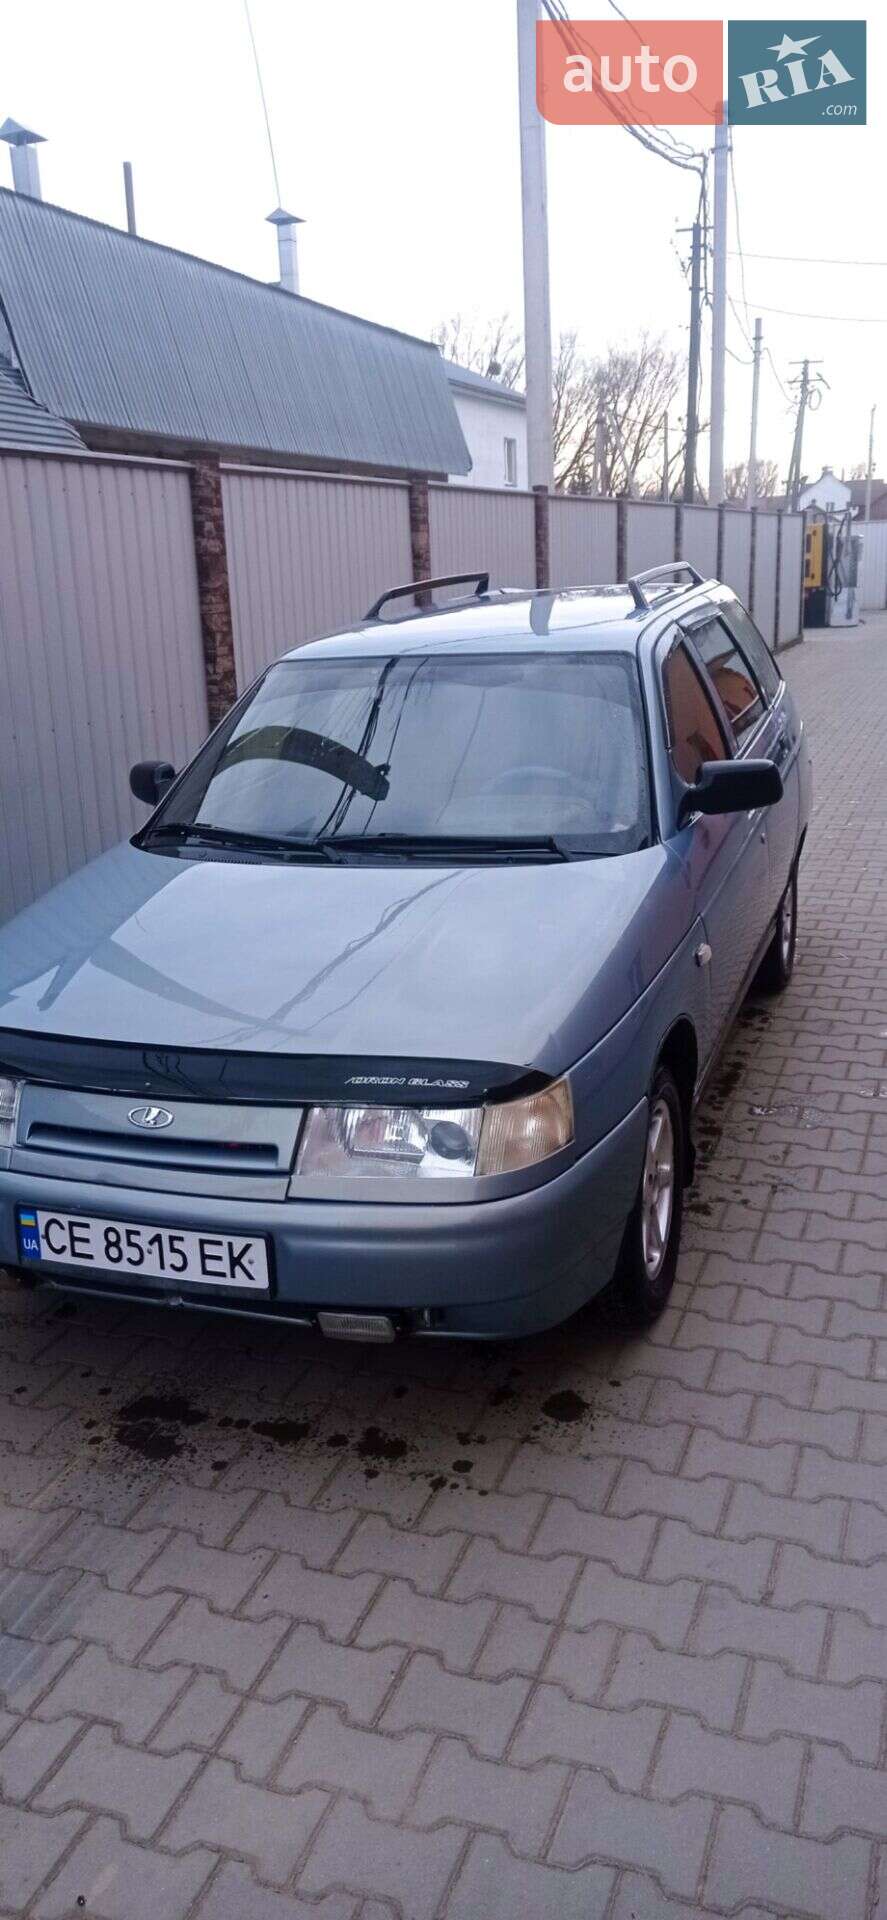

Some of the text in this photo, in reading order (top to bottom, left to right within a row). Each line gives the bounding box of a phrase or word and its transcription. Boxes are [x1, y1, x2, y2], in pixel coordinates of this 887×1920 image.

[408, 1077, 470, 1089] GLASS
[23, 1238, 39, 1251] UA
[44, 1218, 256, 1280] CE 8515 EK
